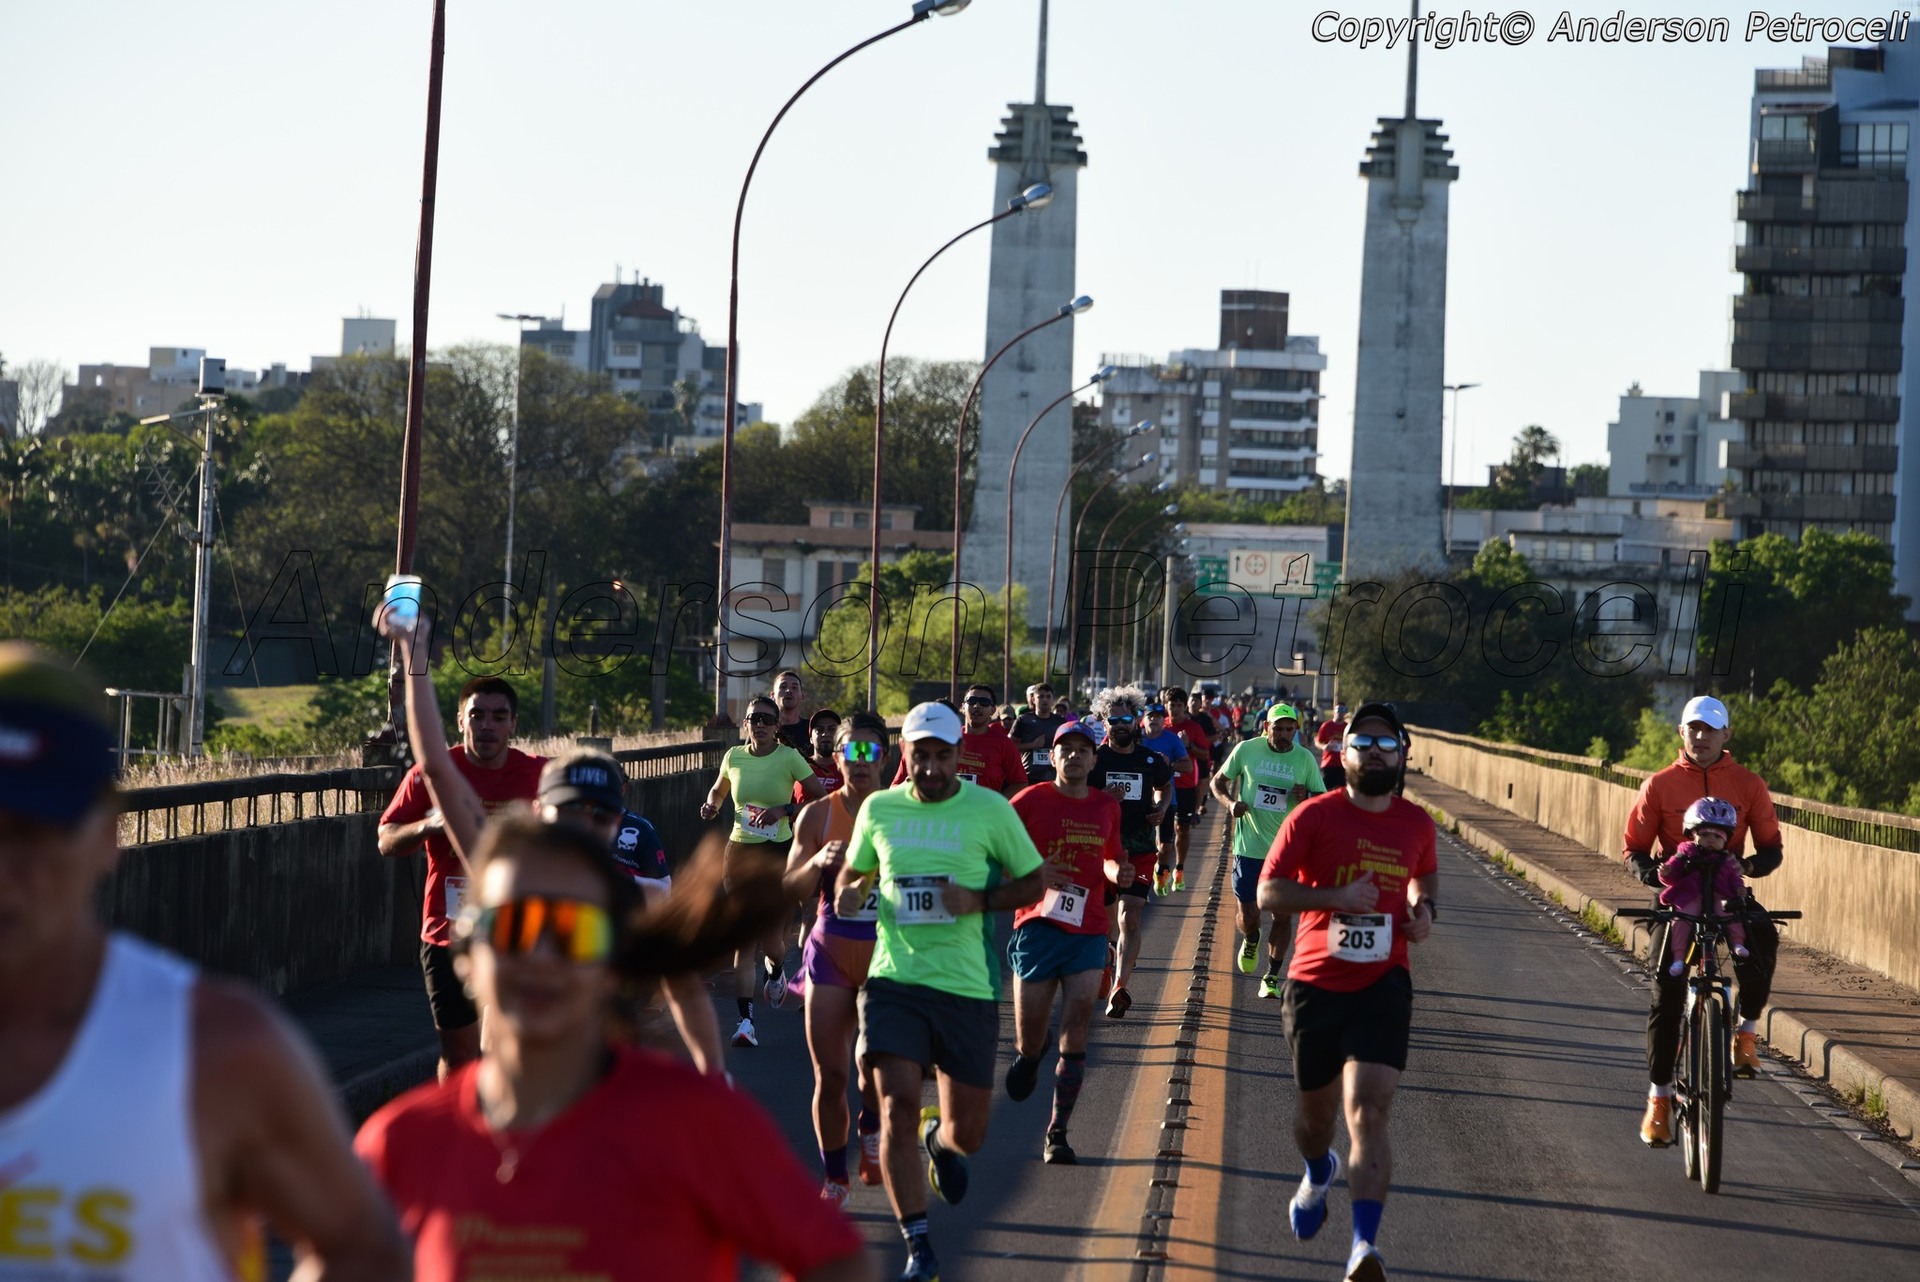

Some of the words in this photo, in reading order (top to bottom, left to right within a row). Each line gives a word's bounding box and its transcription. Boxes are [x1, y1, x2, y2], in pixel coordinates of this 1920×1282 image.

[1262, 793, 1277, 805] 20
[906, 891, 934, 911] 118
[1060, 895, 1075, 913] 19
[1338, 930, 1376, 949] 203
